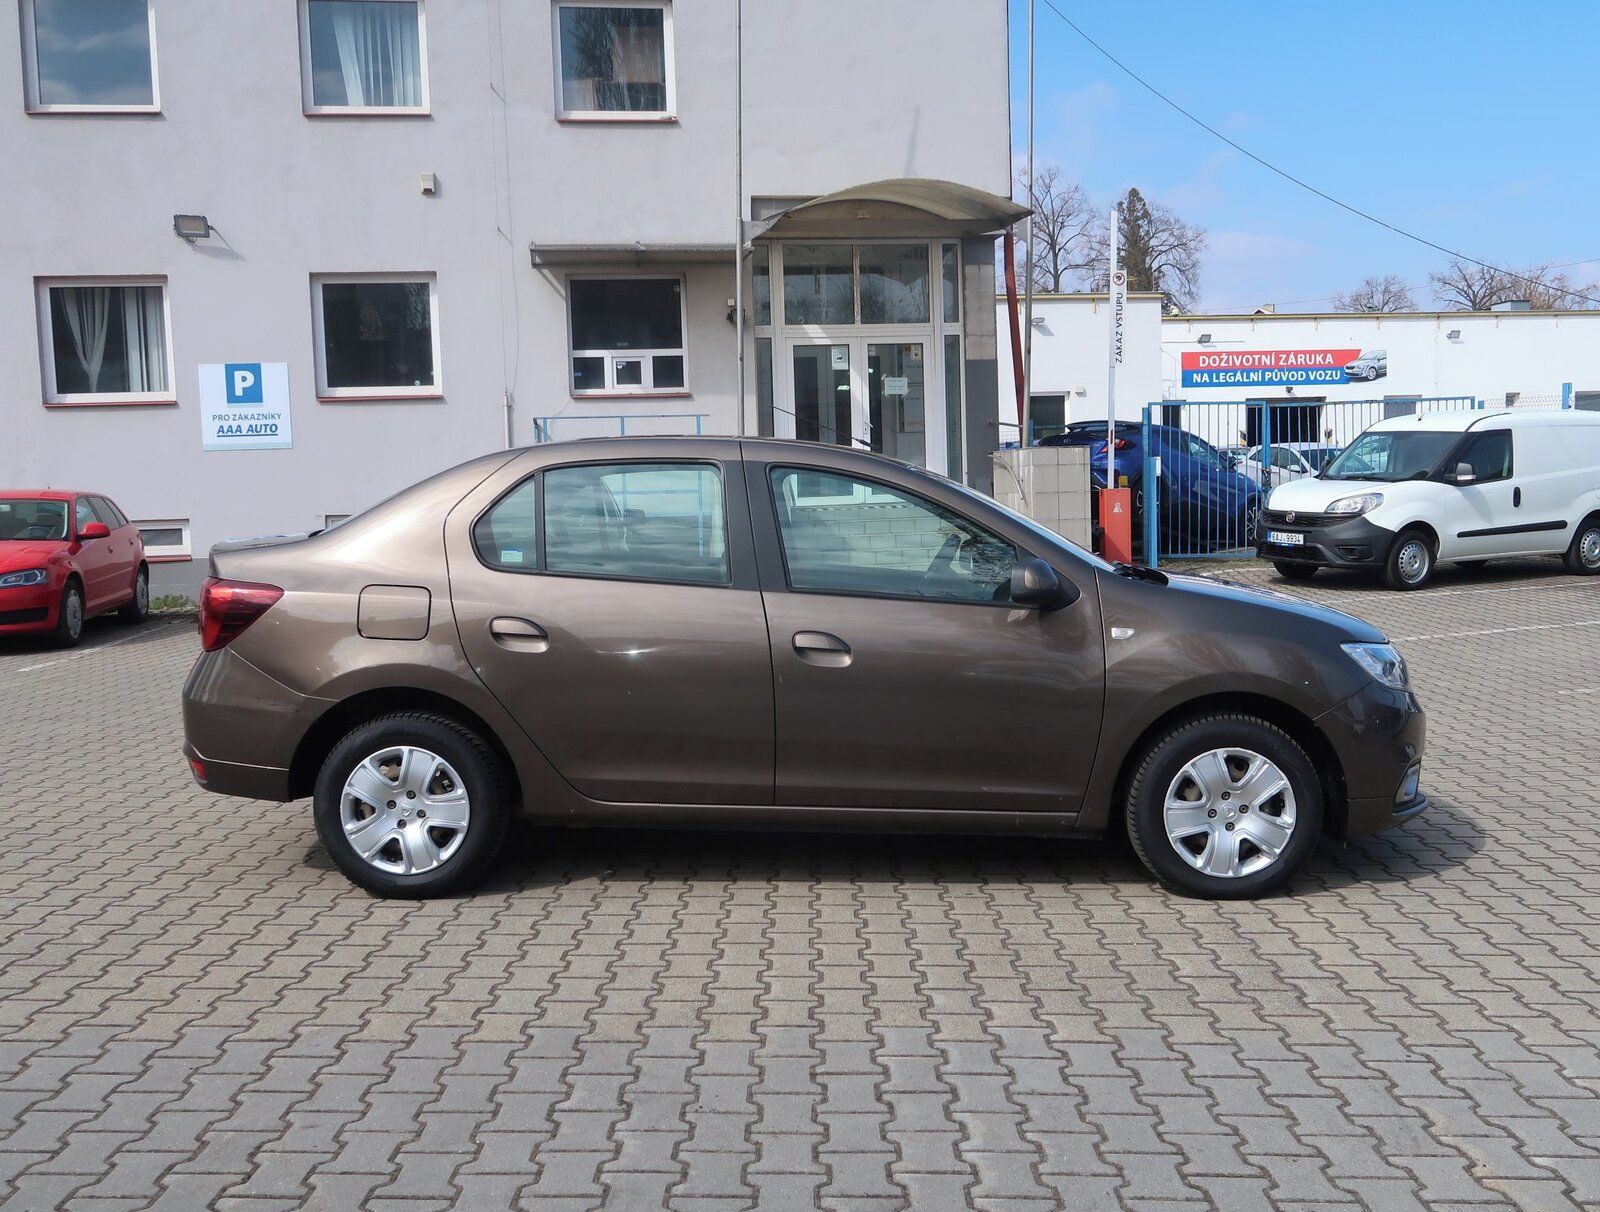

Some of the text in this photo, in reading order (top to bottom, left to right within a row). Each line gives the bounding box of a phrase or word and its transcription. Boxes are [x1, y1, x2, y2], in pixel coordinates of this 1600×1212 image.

[1199, 351, 1334, 367] DOŽIVOTNÍ ZÁRUKA
[234, 370, 255, 396] P
[1193, 369, 1340, 383] NA LEGÁLNÍ PŮVOD VOZU
[232, 412, 281, 420] ZÁKAZNÍKY
[217, 424, 278, 434] AAA AUTO
